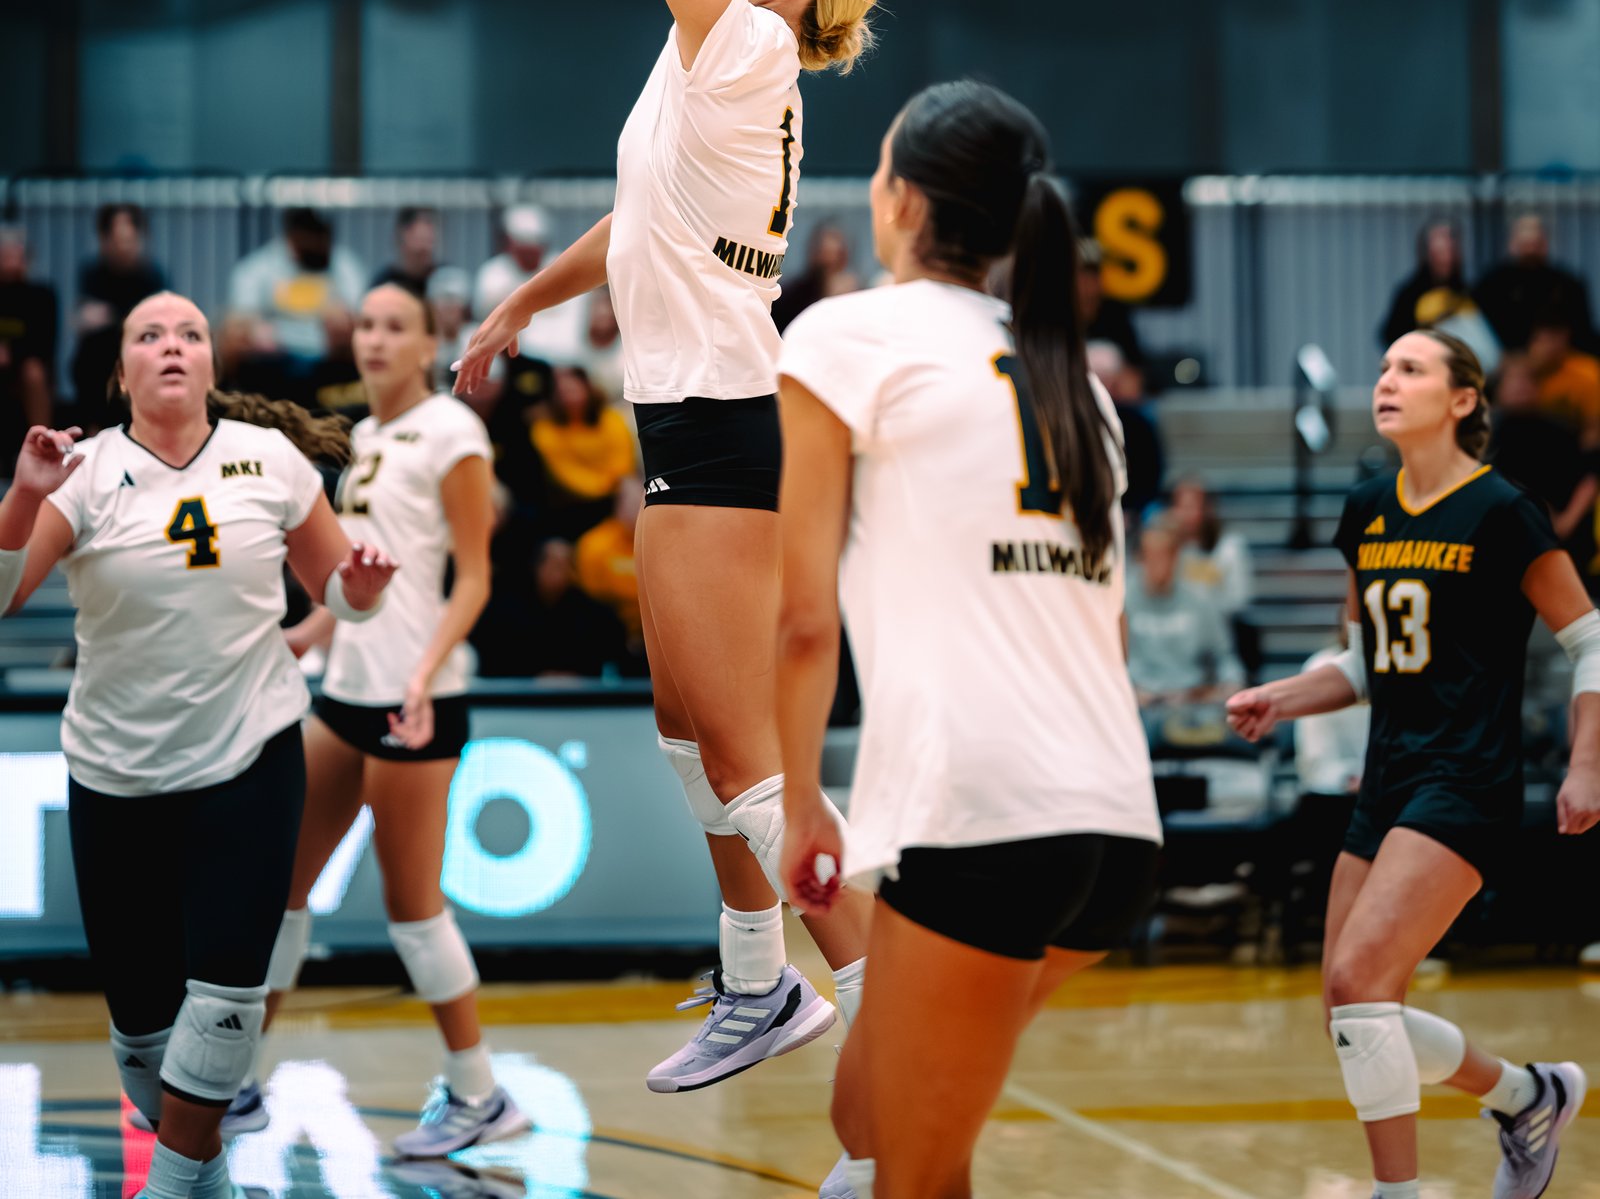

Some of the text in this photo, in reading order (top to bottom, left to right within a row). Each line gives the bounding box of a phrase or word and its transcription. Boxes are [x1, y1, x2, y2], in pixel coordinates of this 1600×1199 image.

[1094, 188, 1167, 301] S
[164, 495, 221, 570] 4
[1357, 540, 1475, 573] MILWAUKEE
[1364, 578, 1431, 674] 13
